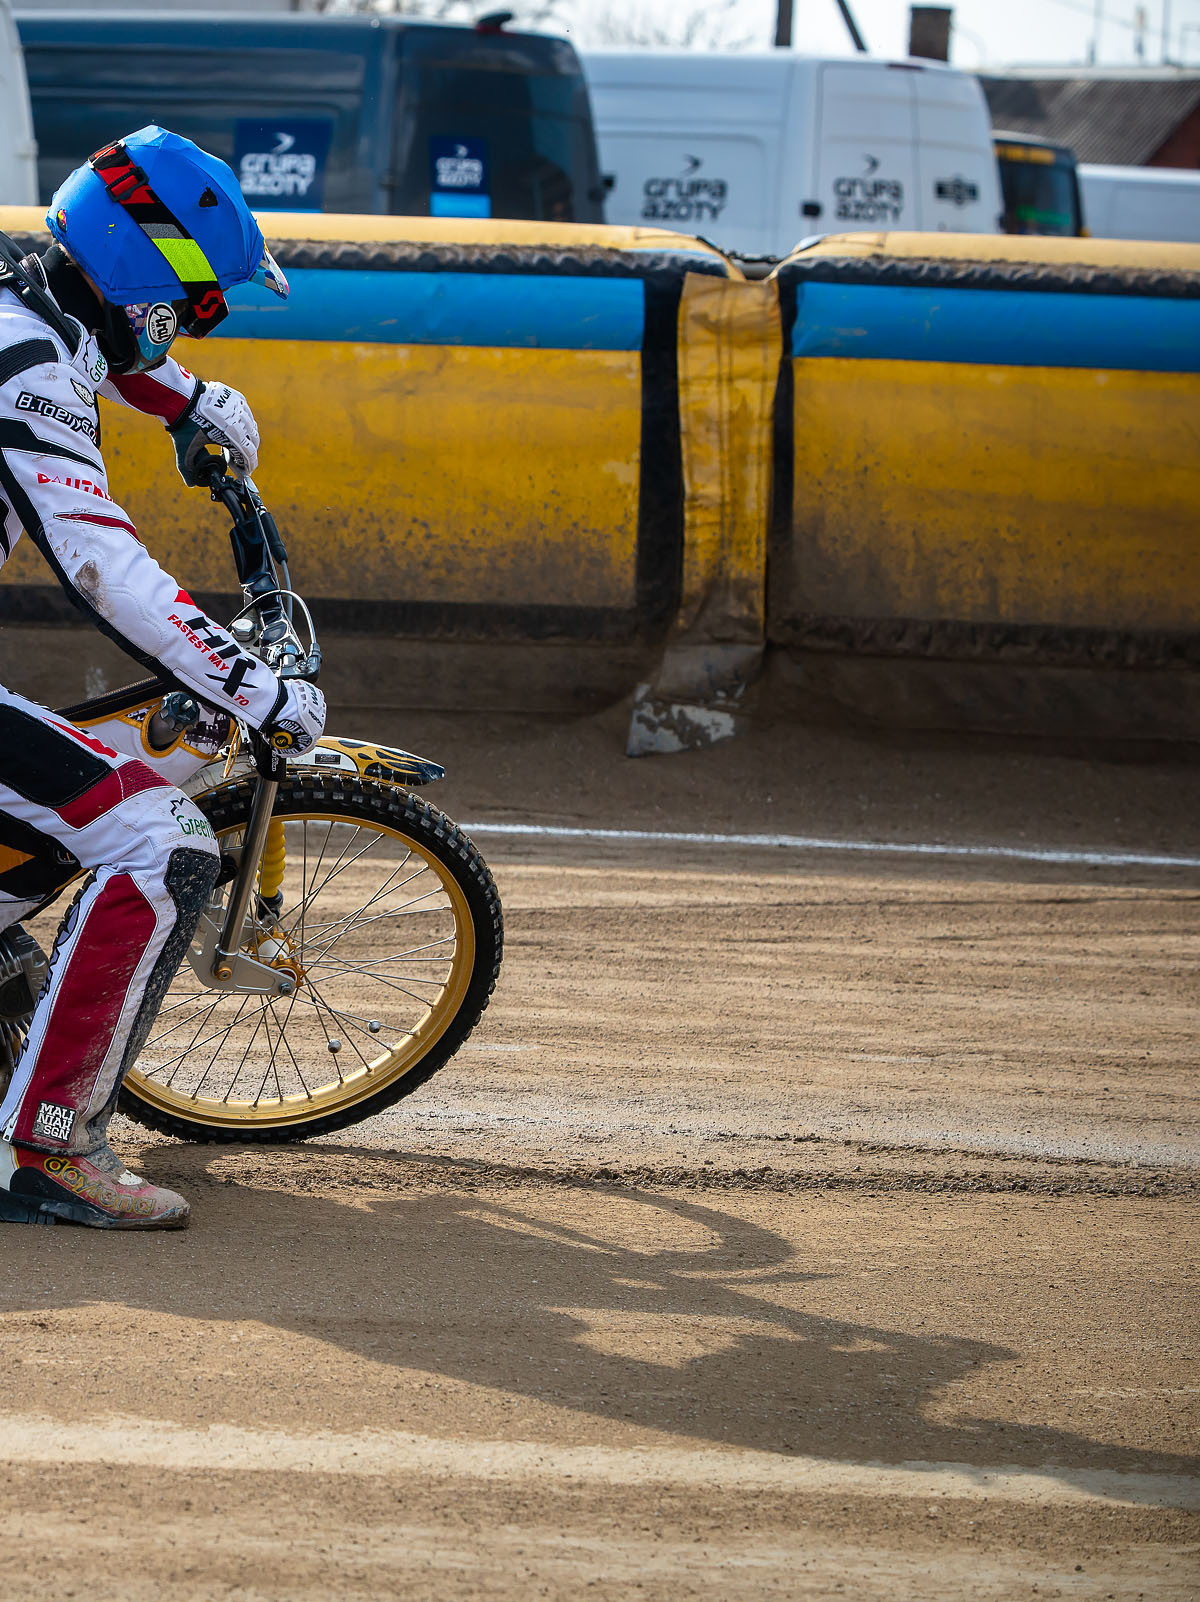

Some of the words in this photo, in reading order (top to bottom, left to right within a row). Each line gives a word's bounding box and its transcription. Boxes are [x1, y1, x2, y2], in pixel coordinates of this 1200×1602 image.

[167, 613, 211, 653] FASTEST
[207, 652, 230, 672] WAY
[234, 694, 250, 707] TO
[39, 1102, 76, 1121] MALI
[33, 1123, 70, 1141] SGN
